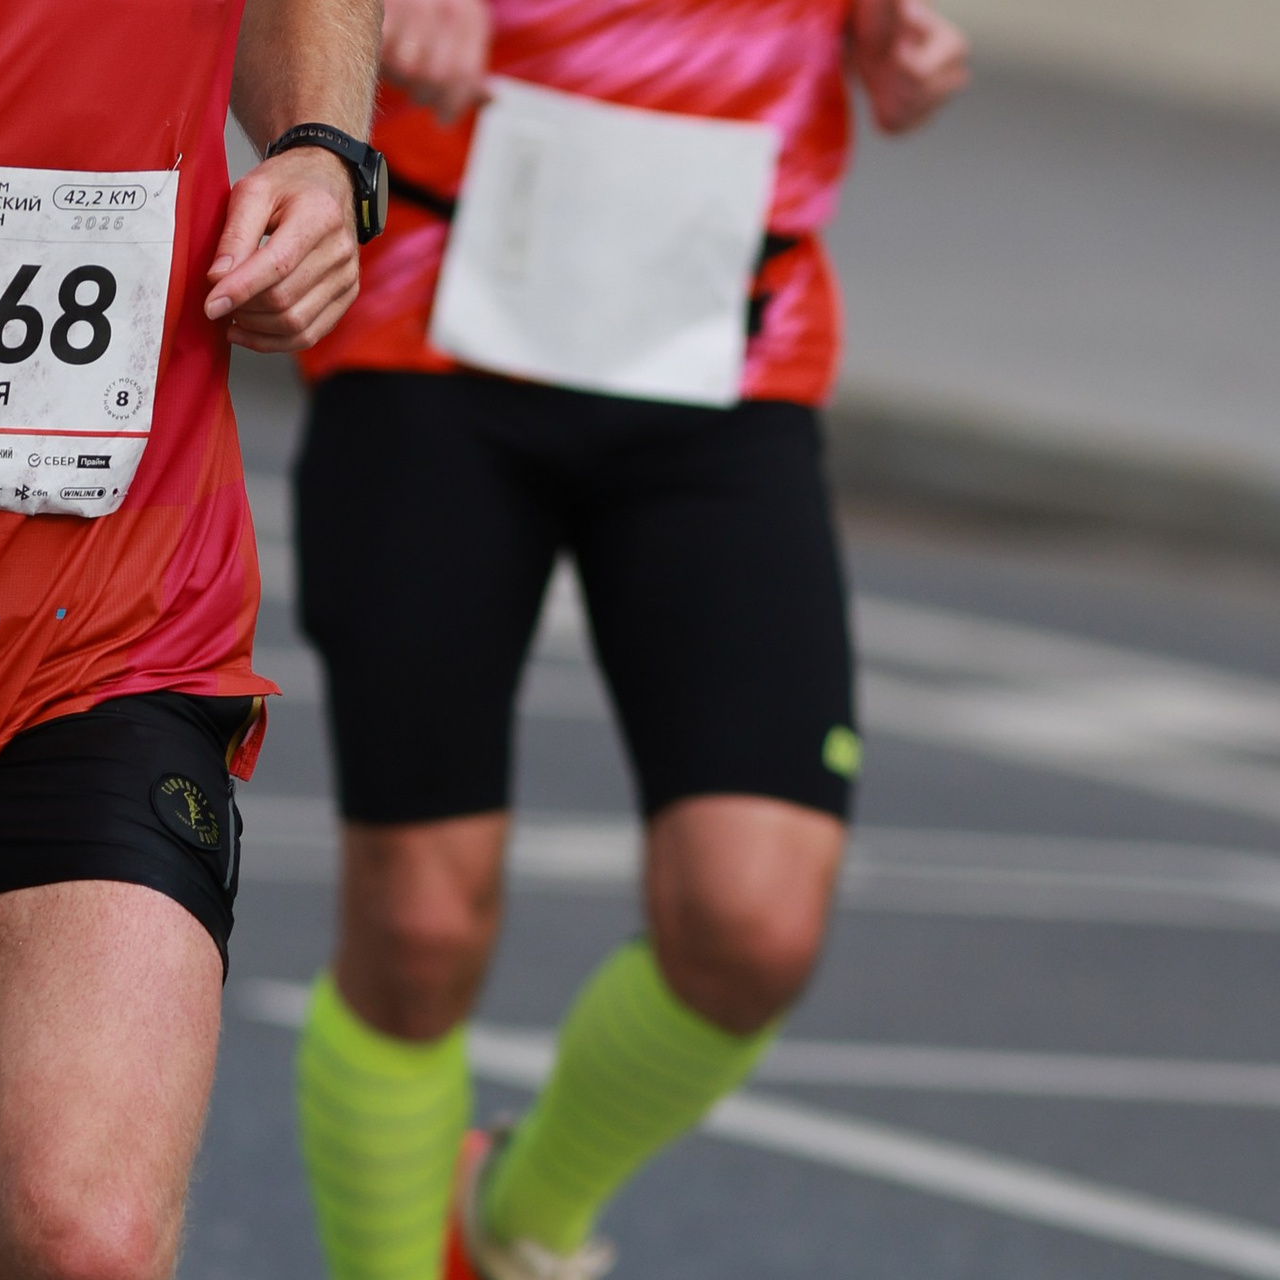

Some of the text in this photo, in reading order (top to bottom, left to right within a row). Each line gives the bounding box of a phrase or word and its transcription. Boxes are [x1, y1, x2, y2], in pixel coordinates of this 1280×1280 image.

[63, 189, 137, 207] 42,2 КМ
[71, 215, 125, 231] 2026
[115, 390, 129, 407] 8
[44, 456, 75, 466] СБЕР
[63, 489, 96, 497] WINLINE
